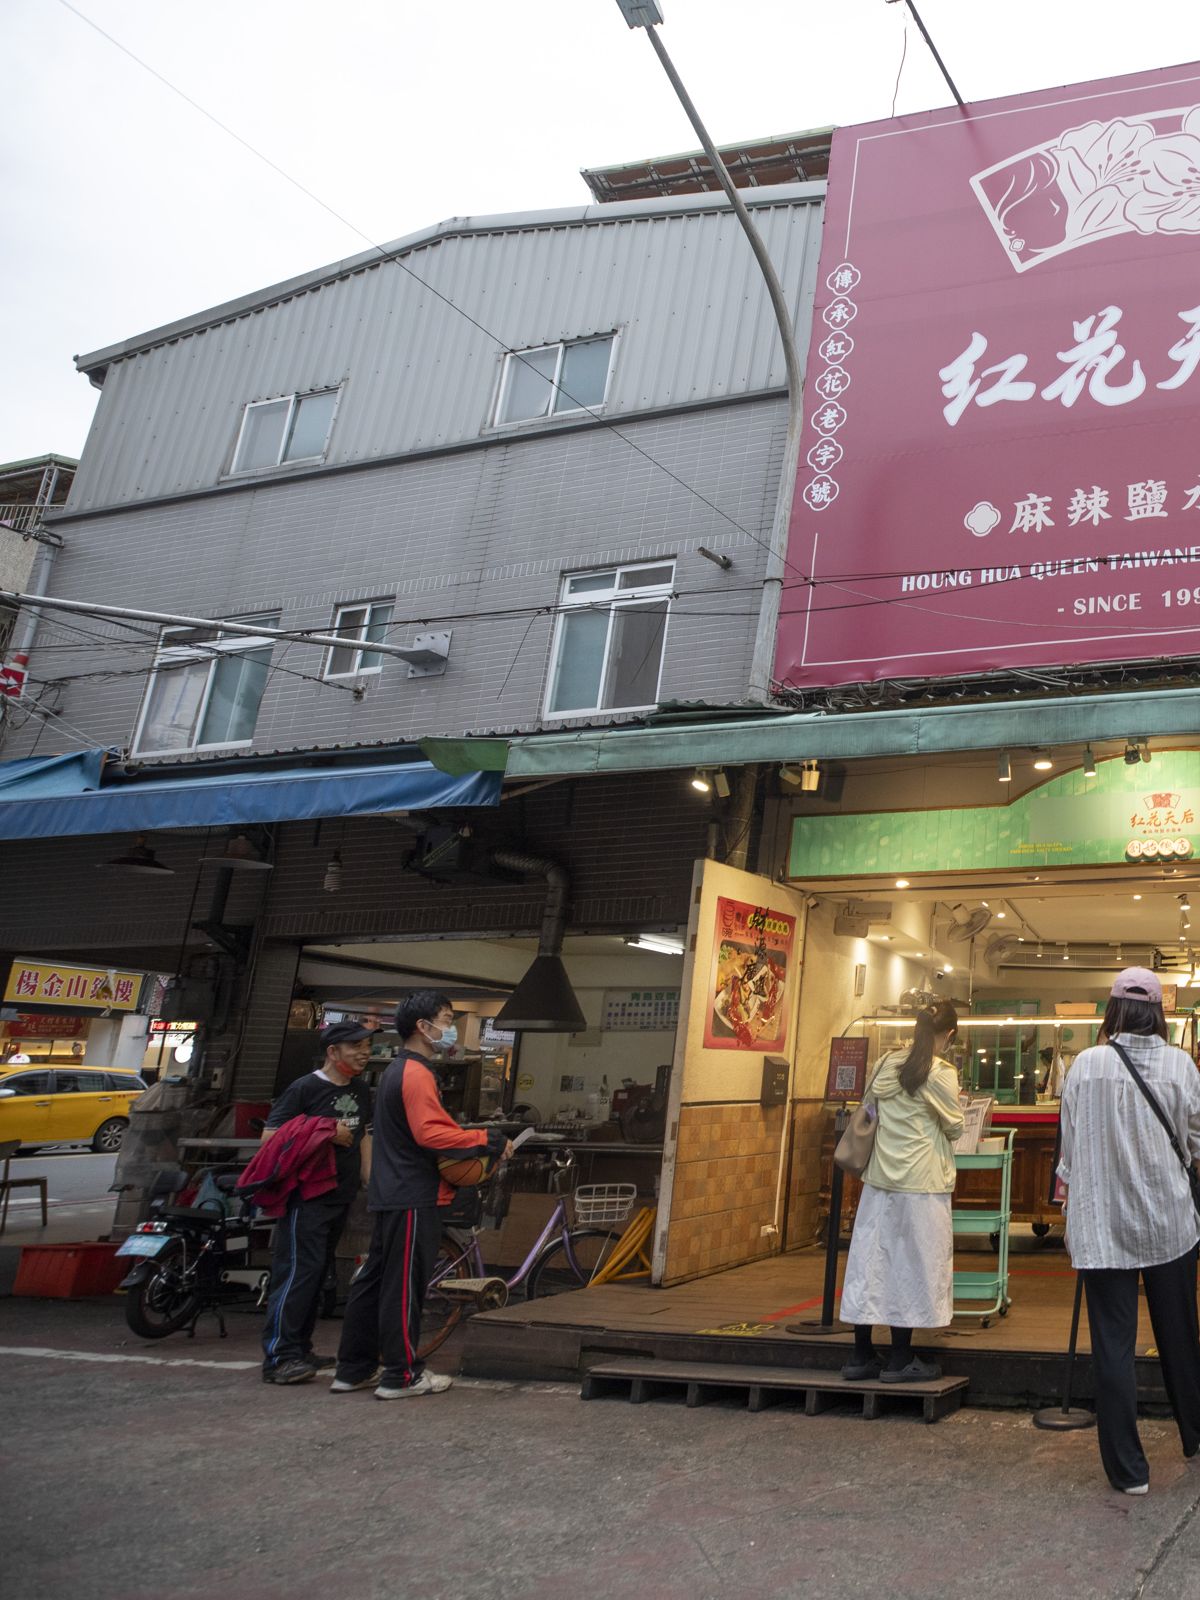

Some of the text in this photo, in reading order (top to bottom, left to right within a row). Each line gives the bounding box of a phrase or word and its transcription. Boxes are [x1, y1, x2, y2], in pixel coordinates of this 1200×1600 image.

[811, 269, 852, 504] 傳承紅花老字號
[901, 569, 973, 592] HOUNG
[980, 565, 1022, 585] HUA
[1029, 558, 1100, 580] QUEEN
[1073, 592, 1143, 616] SINCE
